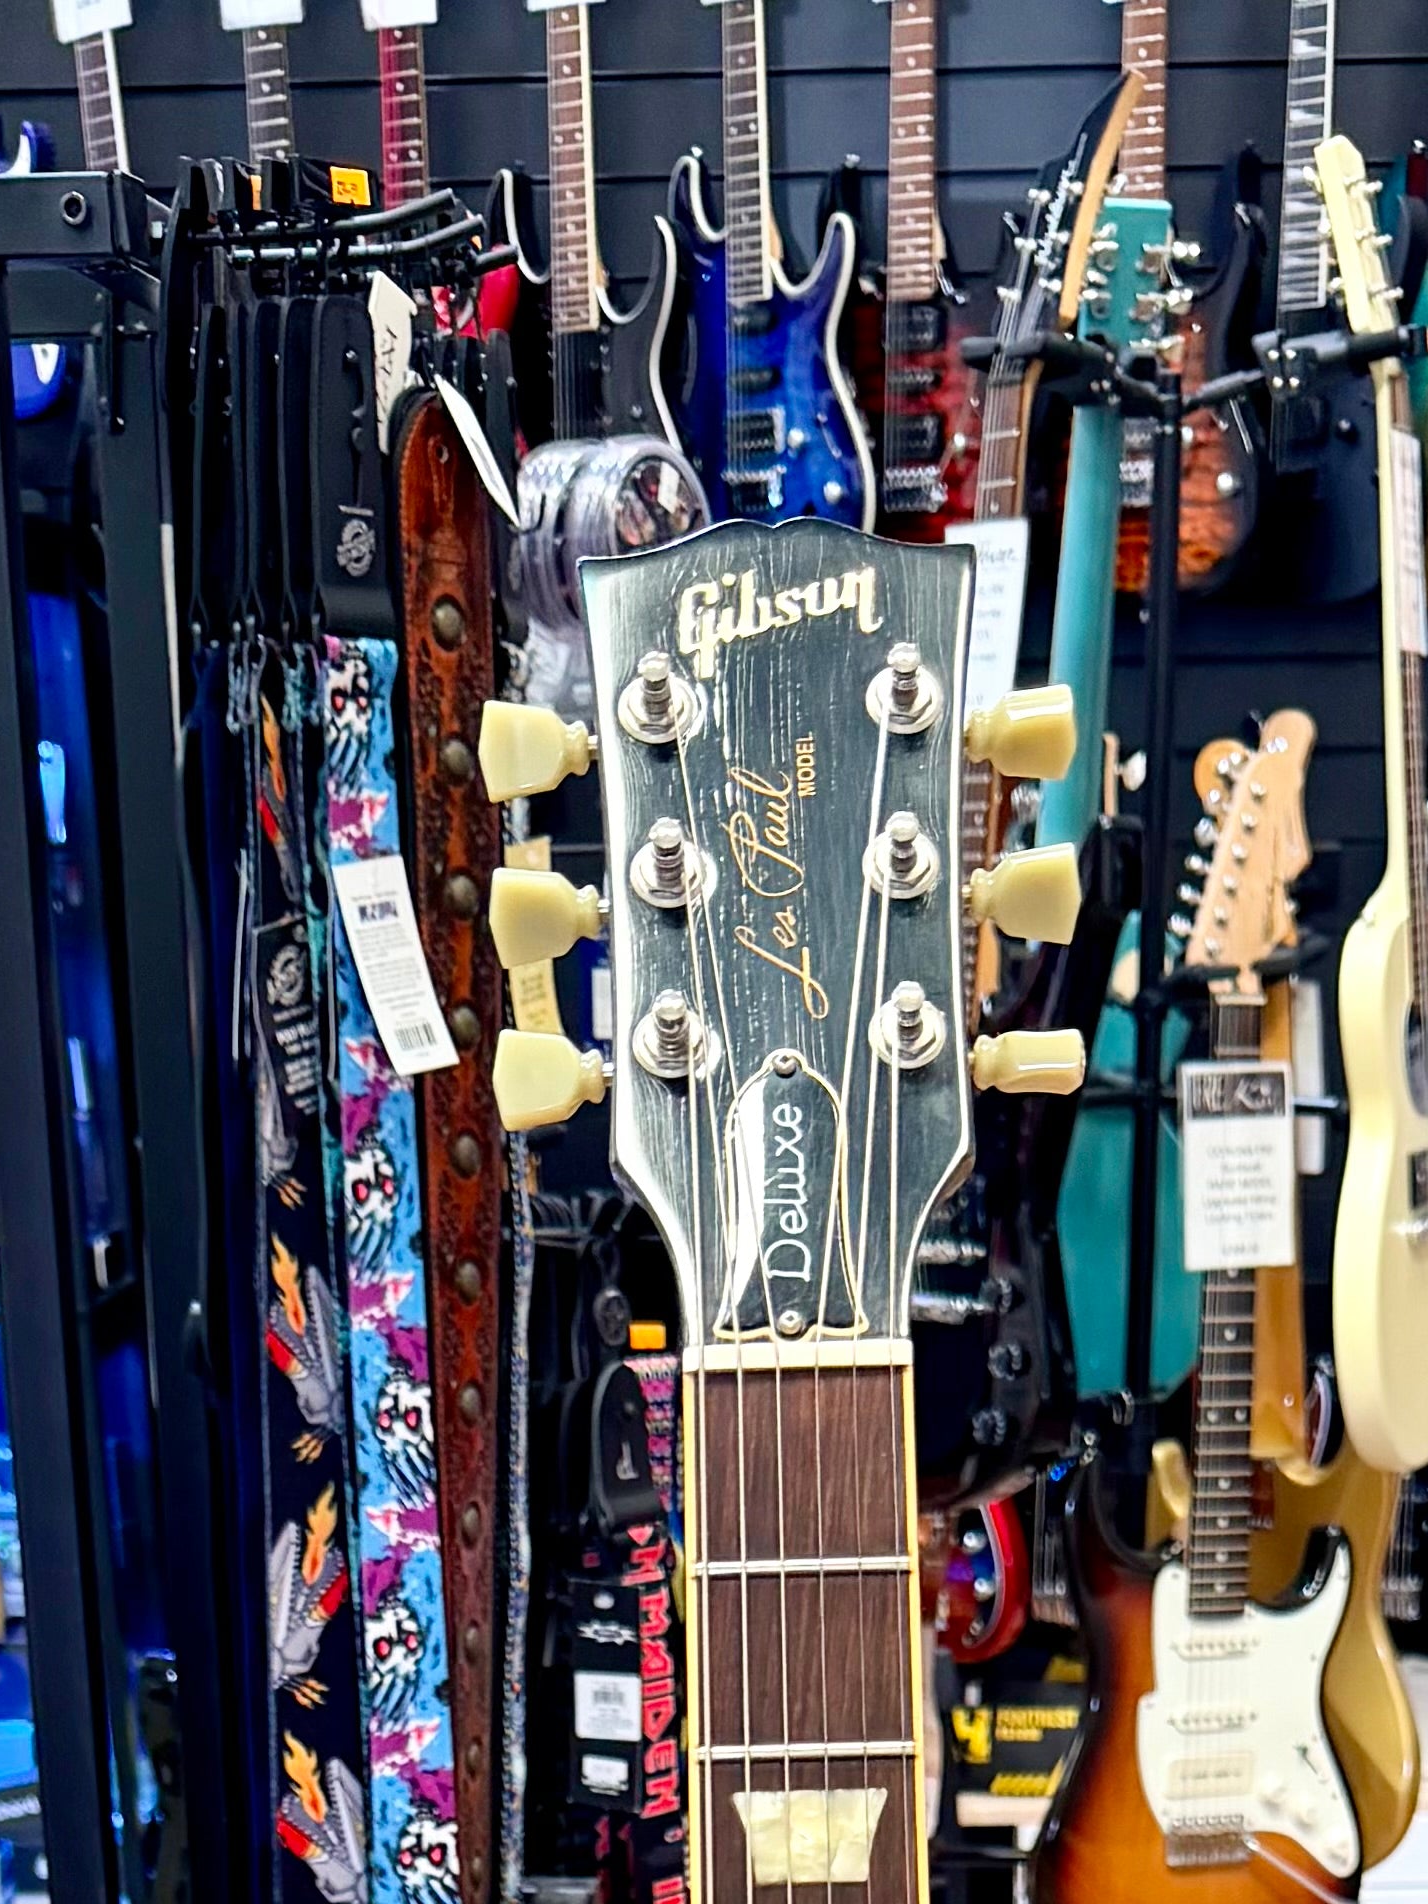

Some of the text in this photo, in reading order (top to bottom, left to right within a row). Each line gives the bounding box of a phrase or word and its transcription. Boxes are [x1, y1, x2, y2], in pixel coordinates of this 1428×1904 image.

[678, 565, 884, 681] Gibson
[797, 732, 816, 799] MODEL
[729, 764, 831, 1021] Les Paul
[767, 1103, 812, 1283] Deluxe
